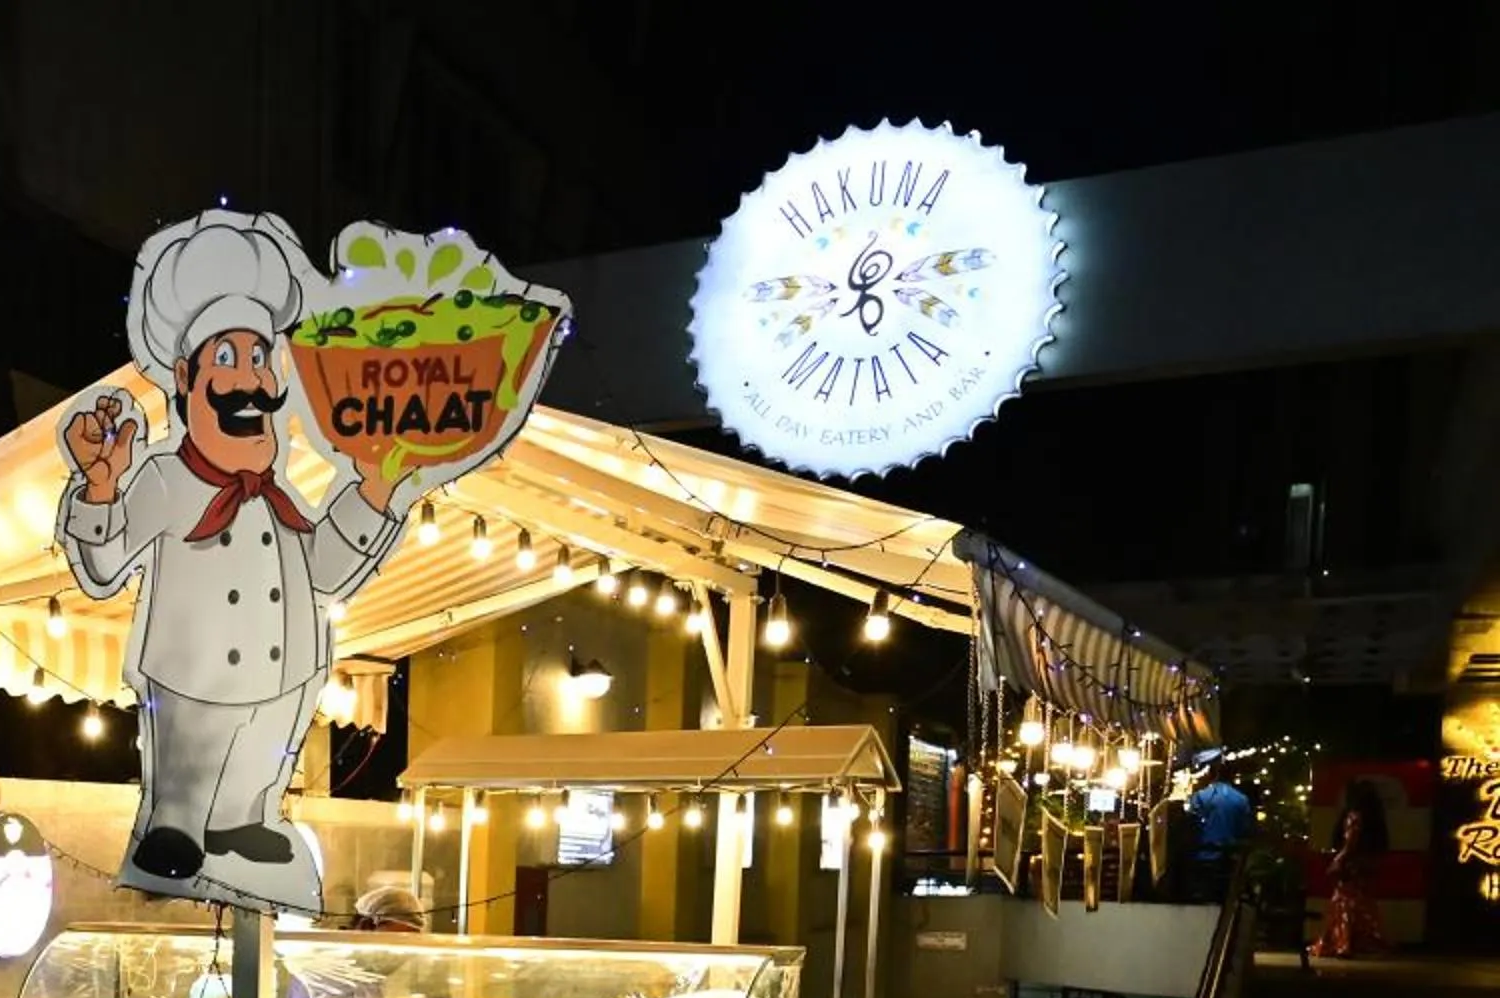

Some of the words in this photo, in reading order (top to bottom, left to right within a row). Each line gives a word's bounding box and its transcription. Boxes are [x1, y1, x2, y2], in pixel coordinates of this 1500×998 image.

[779, 160, 949, 238] HAKUNA
[361, 356, 474, 388] ROYAL
[781, 331, 949, 406] MATATA
[332, 390, 492, 437] CHAAT
[743, 391, 772, 417] ALL
[775, 415, 809, 438] DAY
[819, 426, 892, 445] EATERY
[902, 400, 944, 432] AND
[948, 367, 986, 401] BAR
[1442, 757, 1500, 778] The
